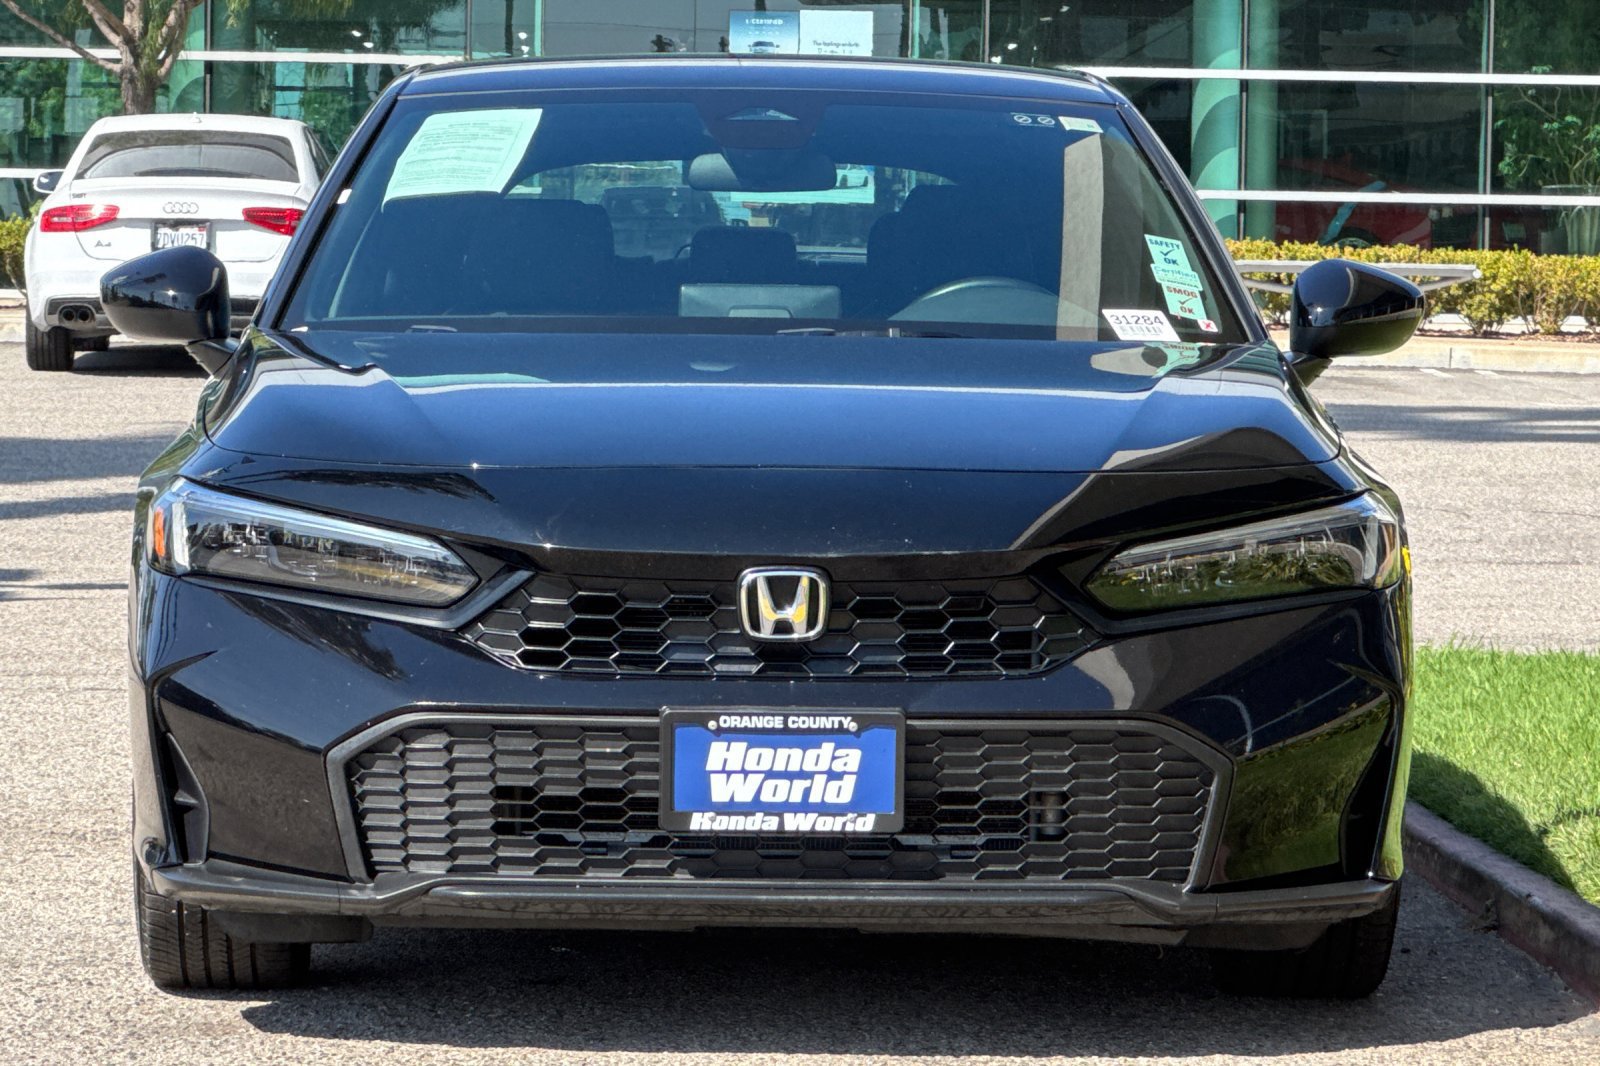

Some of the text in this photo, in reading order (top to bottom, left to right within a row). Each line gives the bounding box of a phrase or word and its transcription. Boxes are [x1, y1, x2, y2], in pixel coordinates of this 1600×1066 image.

[1148, 238, 1181, 250] SAFETY
[1164, 258, 1179, 266] OK
[1154, 265, 1197, 279] Certified
[1166, 286, 1198, 298] SMOG
[1180, 306, 1195, 315] OK
[1110, 314, 1164, 326] 31284
[719, 715, 851, 729] ORANGE COUNTY
[705, 741, 862, 772] Honda
[709, 773, 857, 804] World
[690, 812, 779, 831] Honda
[783, 813, 876, 832] World
